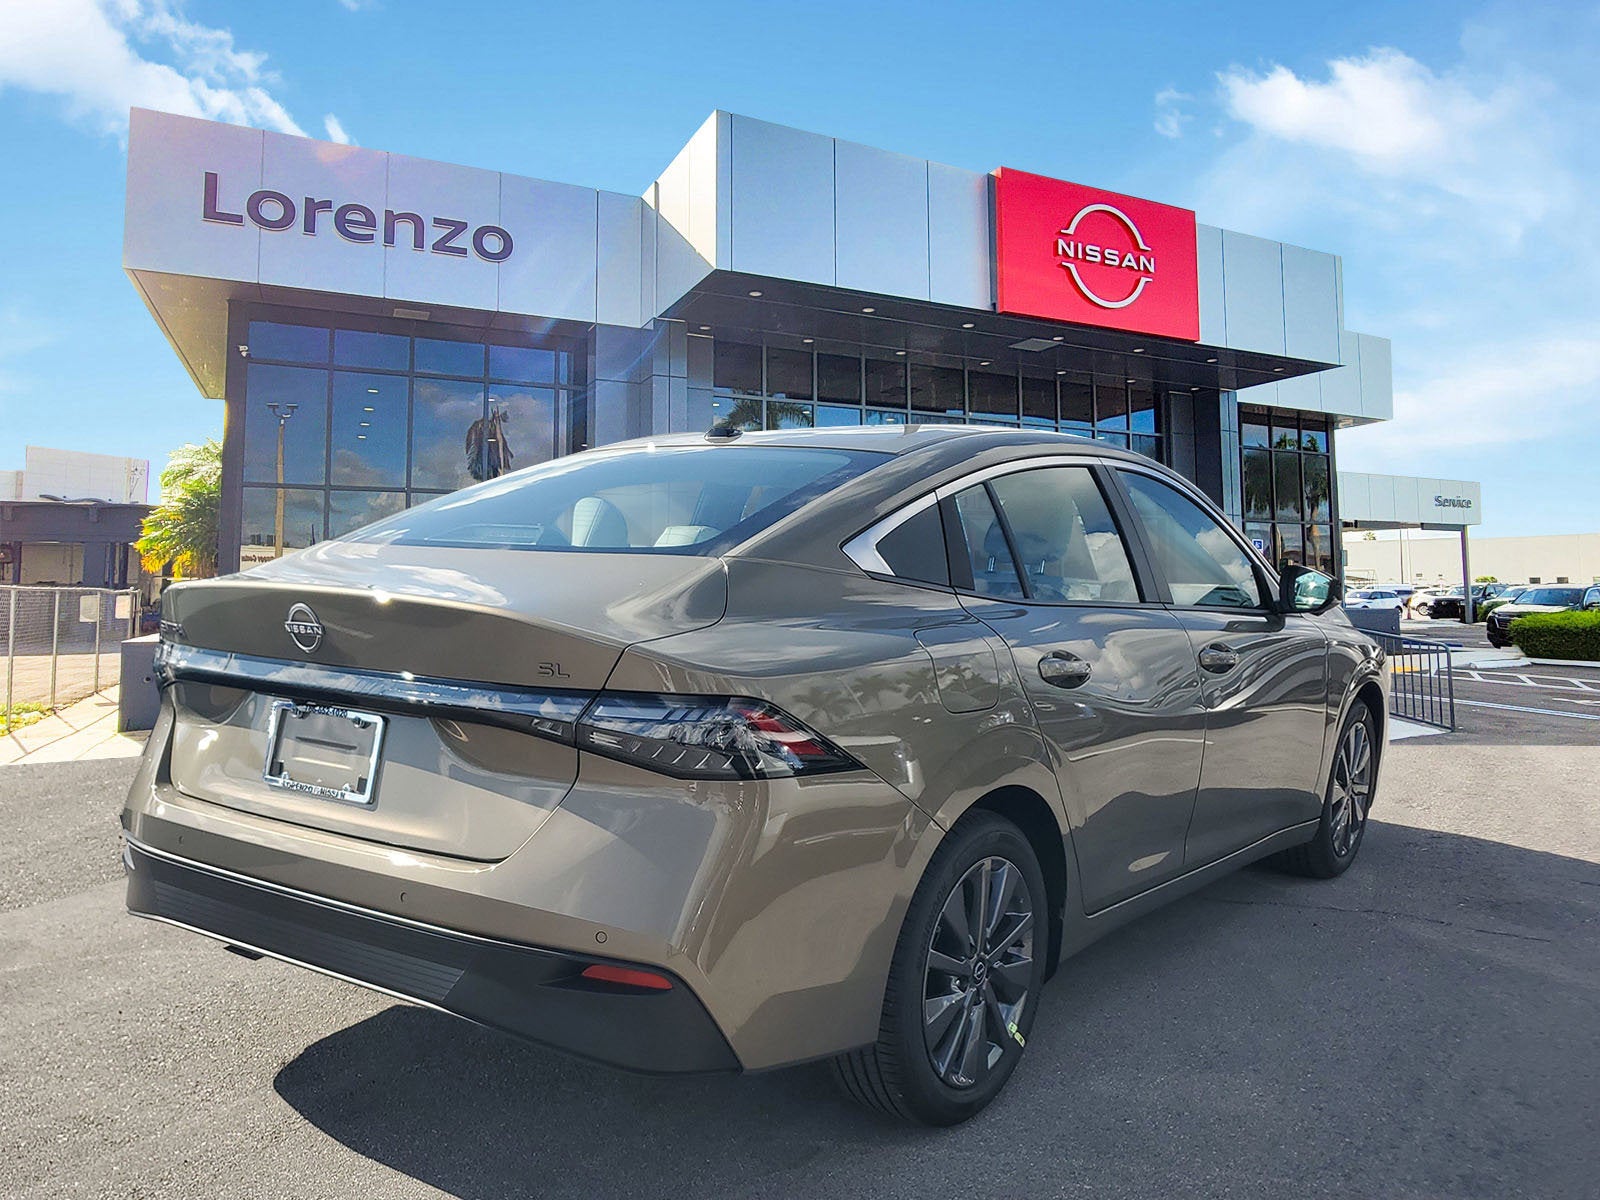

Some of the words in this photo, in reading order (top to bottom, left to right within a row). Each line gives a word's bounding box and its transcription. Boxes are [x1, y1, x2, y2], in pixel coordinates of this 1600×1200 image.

[203, 171, 514, 262] Lorenzo
[1058, 238, 1155, 273] NISSAN
[1434, 495, 1472, 508] Service
[285, 623, 323, 635] NISSAN
[538, 662, 570, 678] SL
